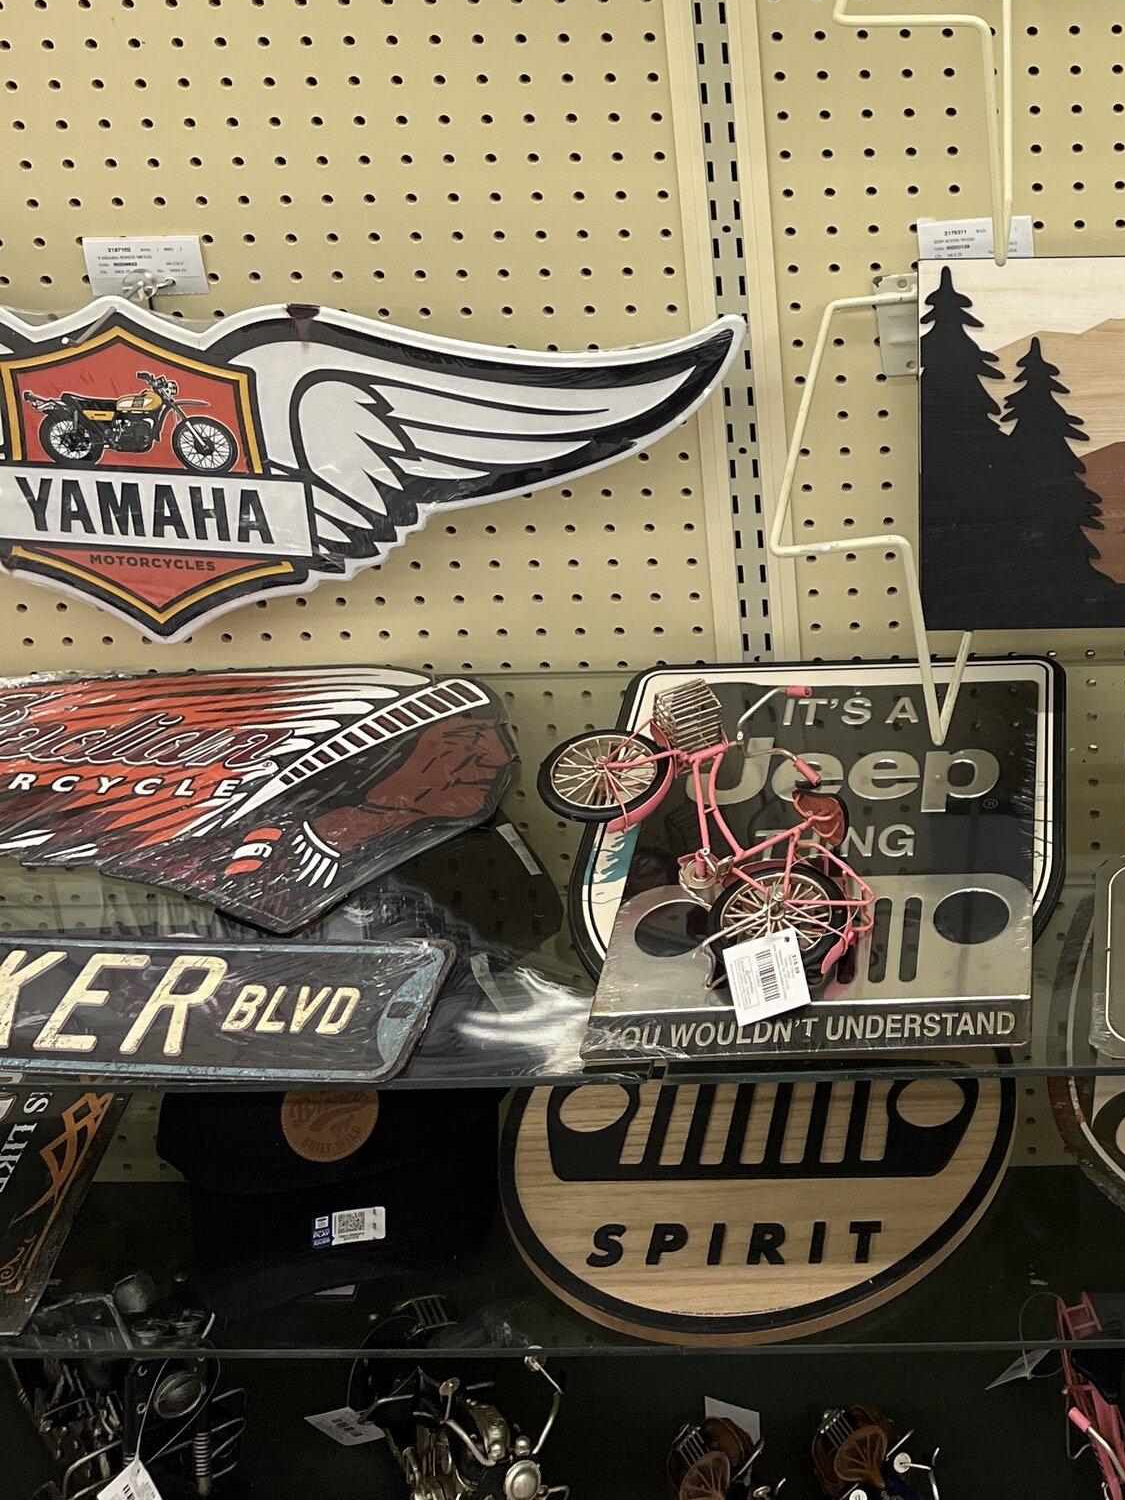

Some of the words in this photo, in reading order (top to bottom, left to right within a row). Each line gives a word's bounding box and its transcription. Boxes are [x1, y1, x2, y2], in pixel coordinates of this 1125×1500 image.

[14, 475, 275, 546] YAMAHA
[89, 553, 217, 575] MOTORCYCLES
[783, 696, 873, 726] IT'S
[885, 697, 919, 724] A
[8, 773, 243, 797] RCYCLE
[685, 736, 1000, 813] Jeep
[755, 823, 916, 861] THNG
[0, 950, 229, 1056] KER
[221, 984, 362, 1035] BLVD
[671, 1017, 817, 1047] WOULDN'T
[825, 1010, 1016, 1041] UNDERSTAND
[586, 1220, 882, 1268] SPIRIT
